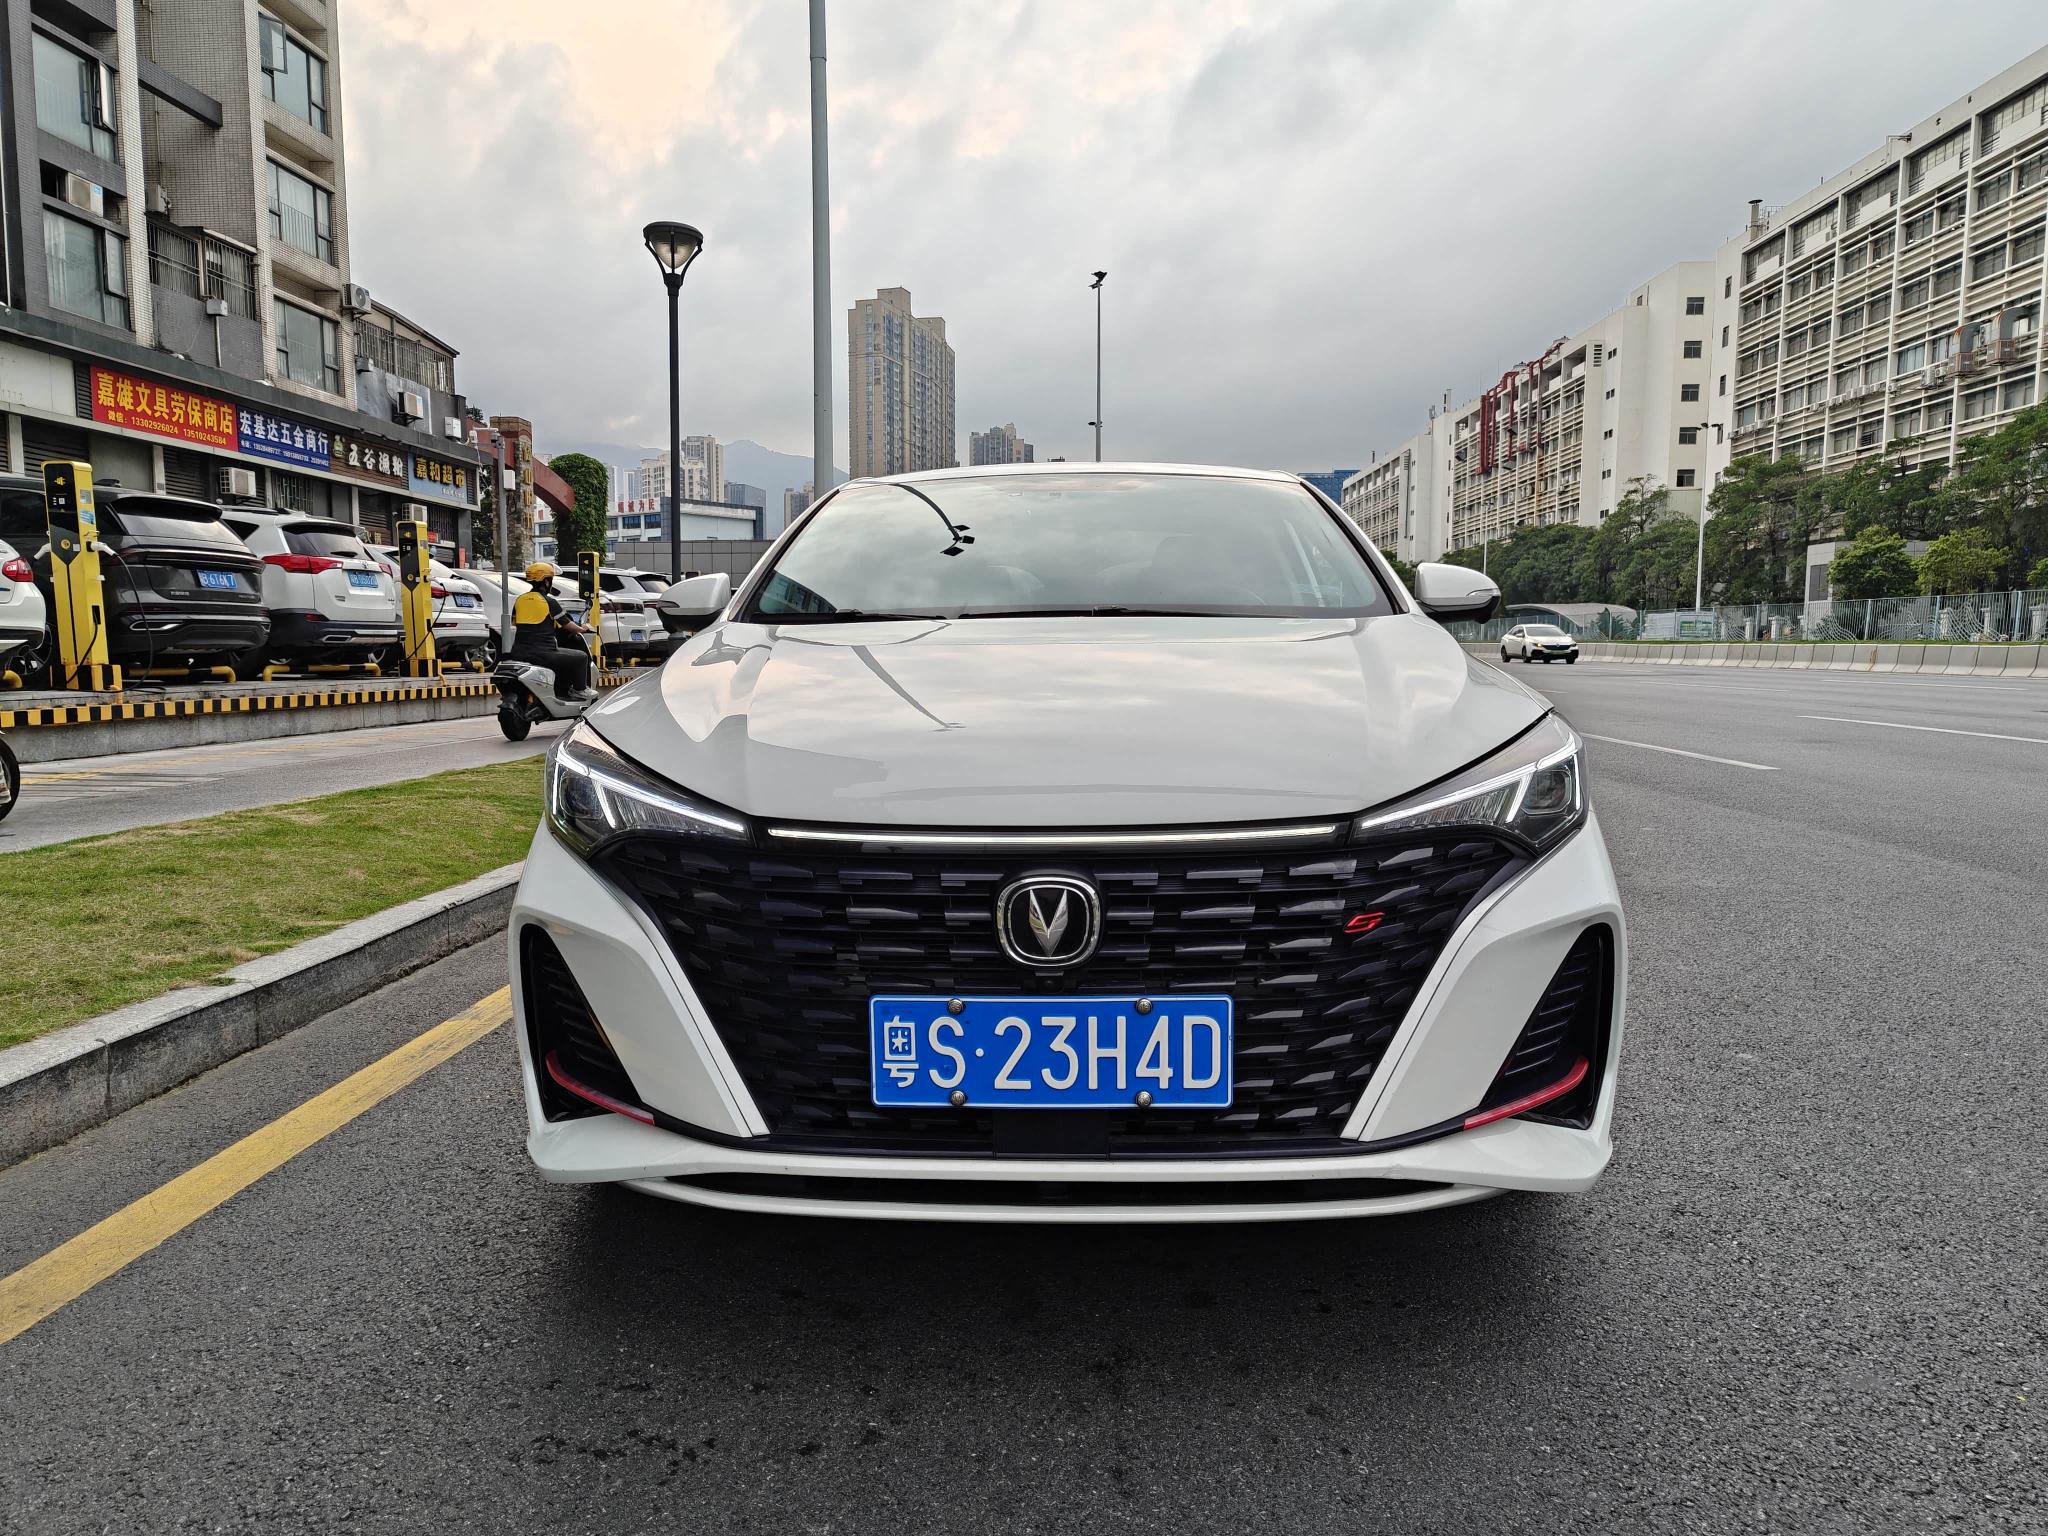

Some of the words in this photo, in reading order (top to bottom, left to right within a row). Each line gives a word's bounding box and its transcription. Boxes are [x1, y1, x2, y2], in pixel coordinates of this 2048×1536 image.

[97, 372, 233, 435] 嘉雄文具劳保商店
[131, 416, 179, 434] 13302926024
[183, 428, 227, 445] 13510243584
[240, 410, 329, 455] 宏基达五金商行
[415, 457, 466, 488] 嘉和超市
